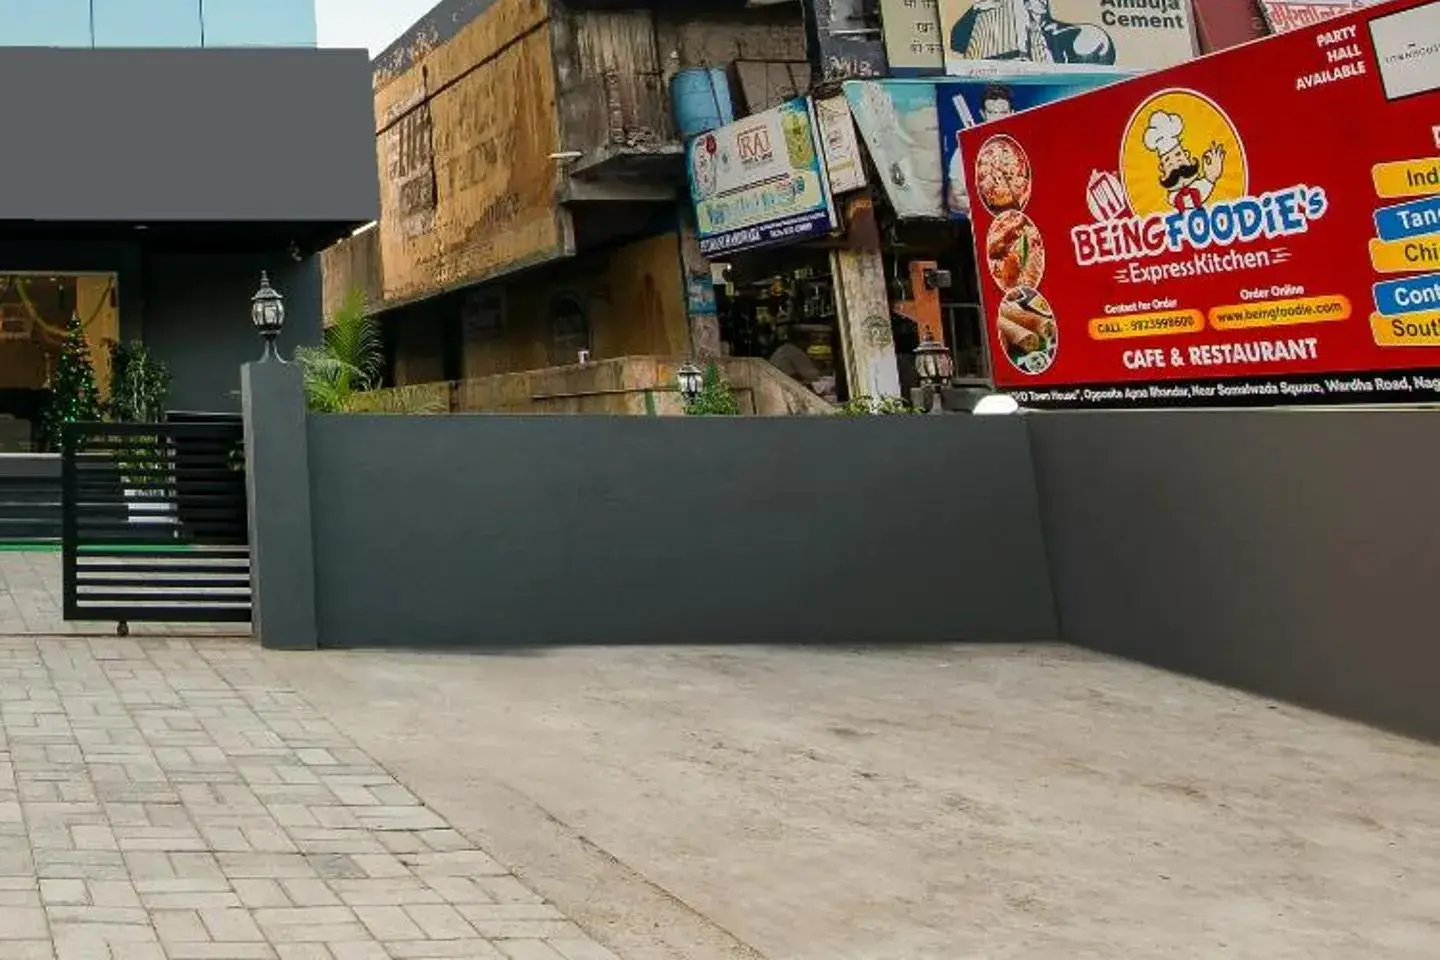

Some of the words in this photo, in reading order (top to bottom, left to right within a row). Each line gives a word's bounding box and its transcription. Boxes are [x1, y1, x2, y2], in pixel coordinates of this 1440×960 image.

[1101, 11, 1186, 30] Cement
[1316, 24, 1357, 48] PARTY
[1327, 42, 1363, 64] HALL
[1296, 61, 1367, 91] AVAILABLE
[1240, 288, 1270, 300] Order
[1122, 346, 1166, 370] CAFE
[1170, 346, 1186, 368] &
[1189, 339, 1318, 367] RESTAURANT
